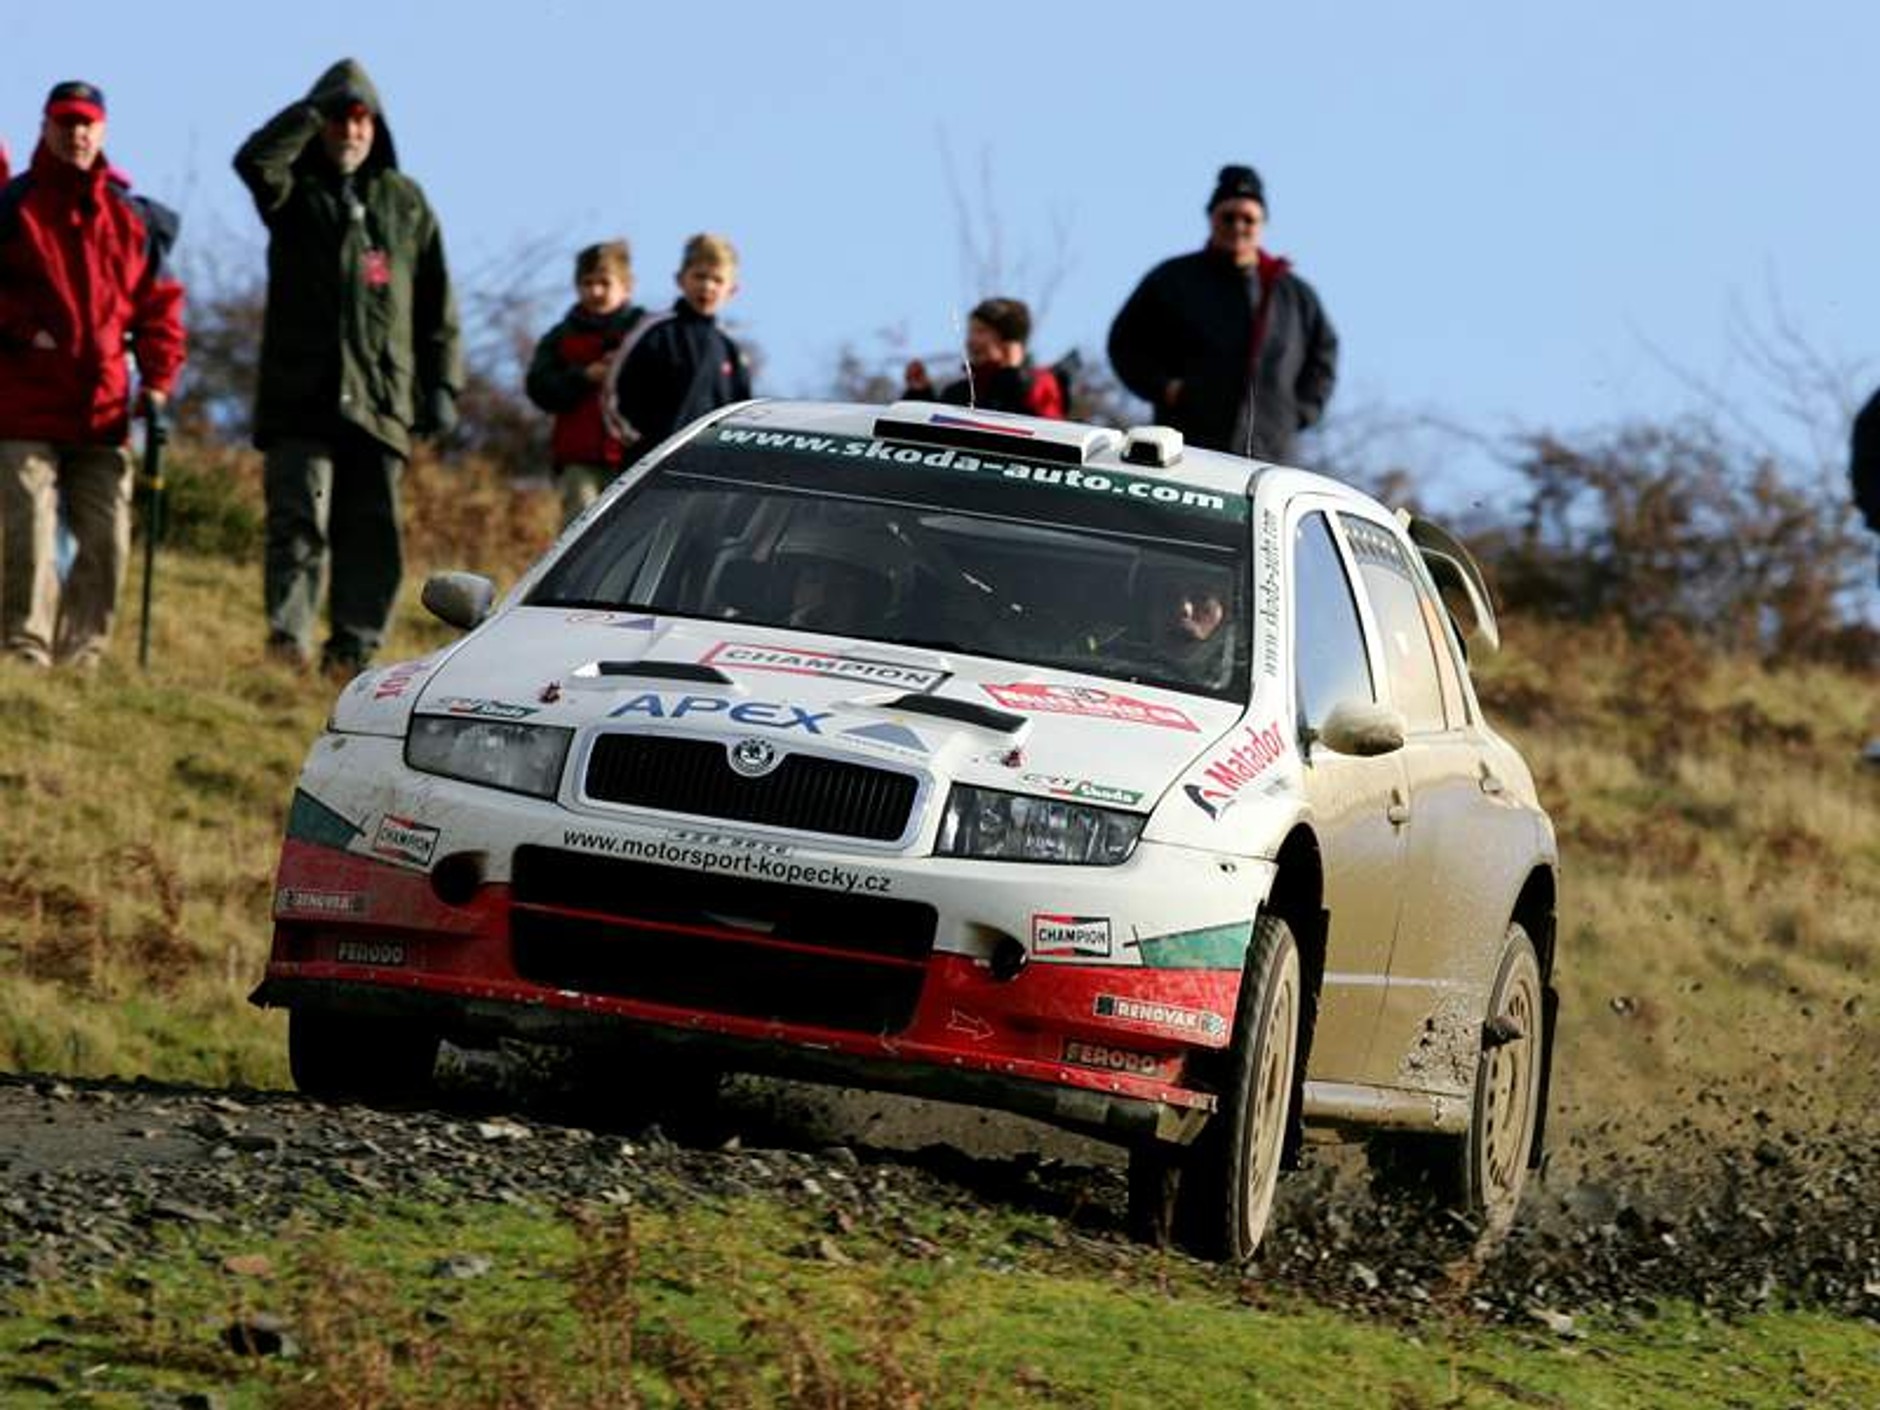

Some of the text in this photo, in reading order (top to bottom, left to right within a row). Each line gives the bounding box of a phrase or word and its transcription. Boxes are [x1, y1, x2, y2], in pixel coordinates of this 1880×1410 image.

[717, 428, 1225, 511] www.skoda-auto.com
[725, 647, 930, 687] CHAMPION
[608, 693, 834, 735] APEX
[1204, 720, 1287, 792] Matador
[563, 828, 892, 894] www.motorsport-kopecky.cz
[1037, 926, 1107, 945] CHAMPION
[1066, 1042, 1157, 1075] FERODO
